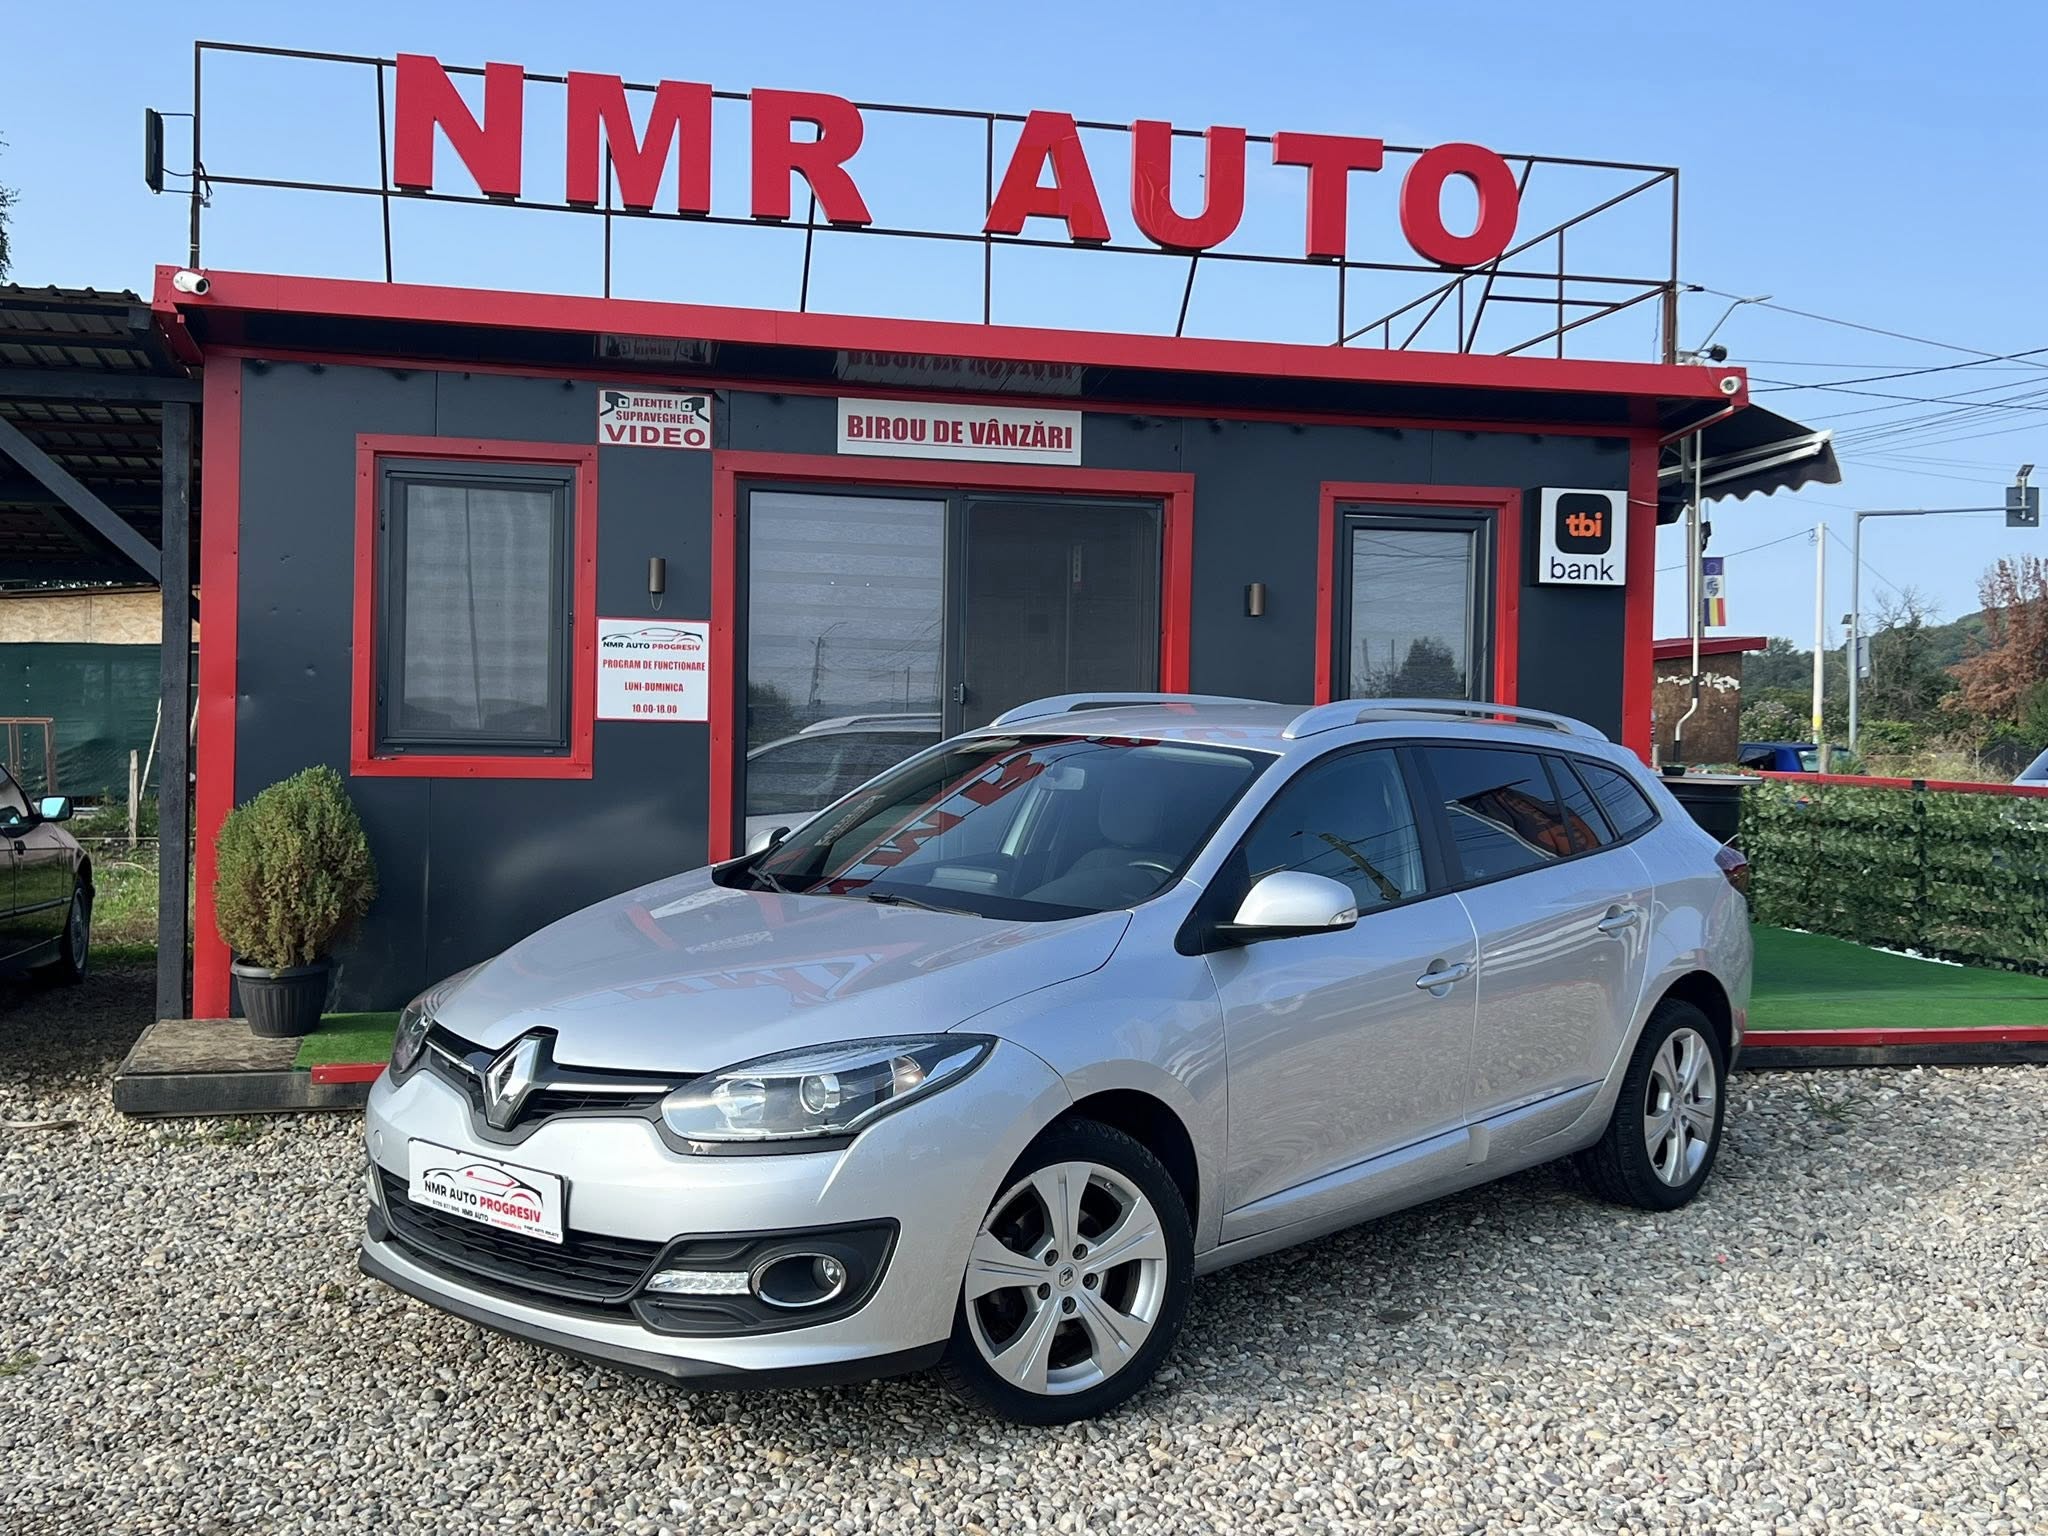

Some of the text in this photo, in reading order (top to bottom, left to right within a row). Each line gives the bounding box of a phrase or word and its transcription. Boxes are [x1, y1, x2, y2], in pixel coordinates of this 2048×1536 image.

[394, 52, 1520, 269] NMR AUTO
[615, 410, 695, 425] SUPRAVEGHERE
[604, 423, 706, 446] VIDEO
[846, 414, 1073, 450] BIROU DE VÂNZĂRI
[1565, 511, 1604, 538] tbi
[1550, 556, 1614, 582] bank
[603, 641, 701, 651] NMR AUTO PROGRESIV
[602, 659, 705, 671] PROGRAM DE FUNCTIONARE
[624, 681, 684, 693] LUNI-DUMINICA
[632, 703, 678, 714] 10.00-18.00
[424, 1180, 446, 1197] NMR
[449, 1188, 477, 1205] AUTO
[480, 1196, 541, 1222] PROGRESIV
